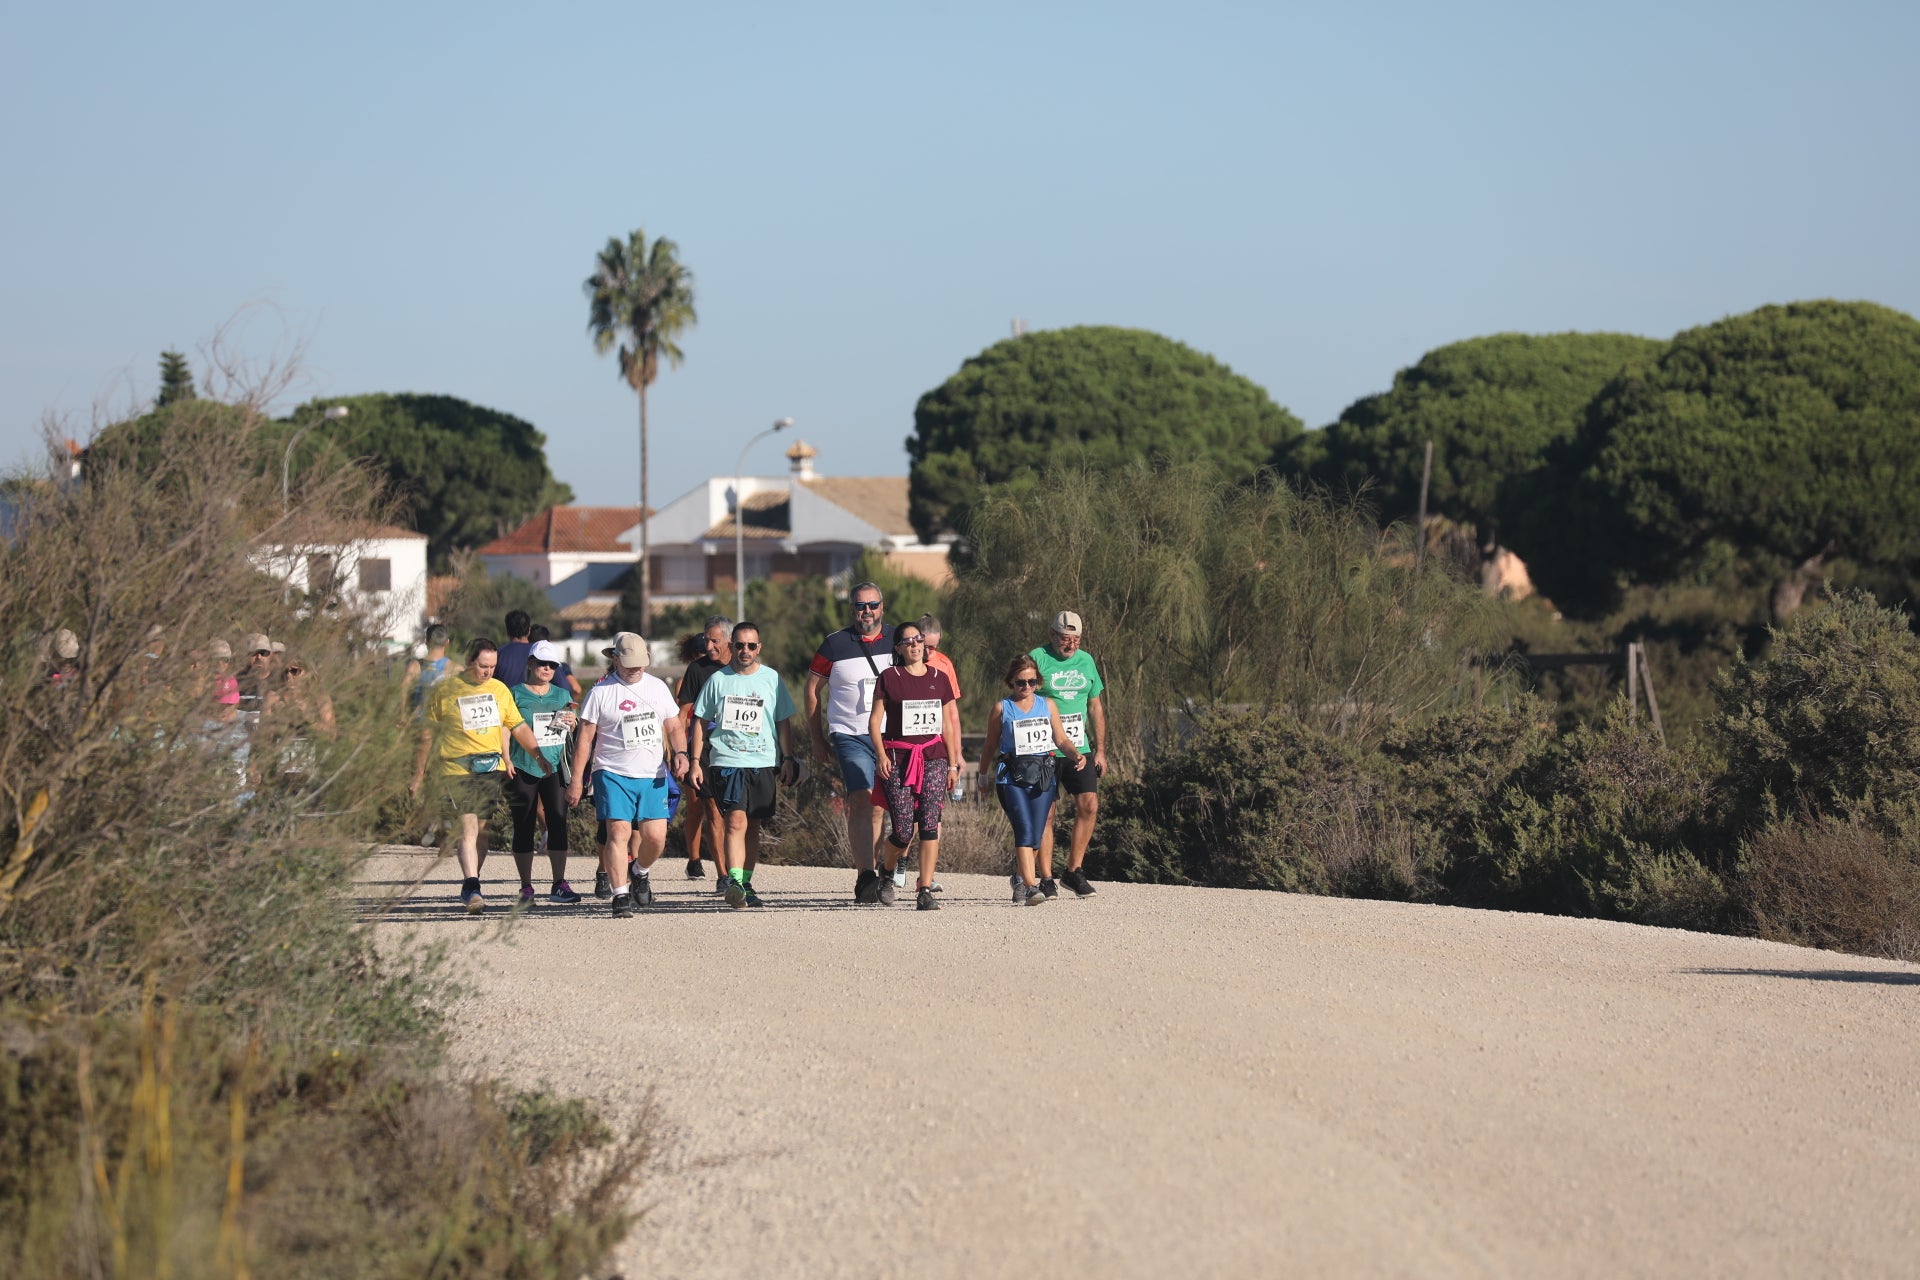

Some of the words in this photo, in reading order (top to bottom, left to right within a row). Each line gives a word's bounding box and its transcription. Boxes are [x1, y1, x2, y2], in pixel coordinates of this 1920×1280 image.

[471, 706, 492, 719] 229
[735, 709, 757, 722] 169
[913, 712, 936, 725] 213
[634, 723, 655, 738] 168
[1026, 730, 1047, 743] 192
